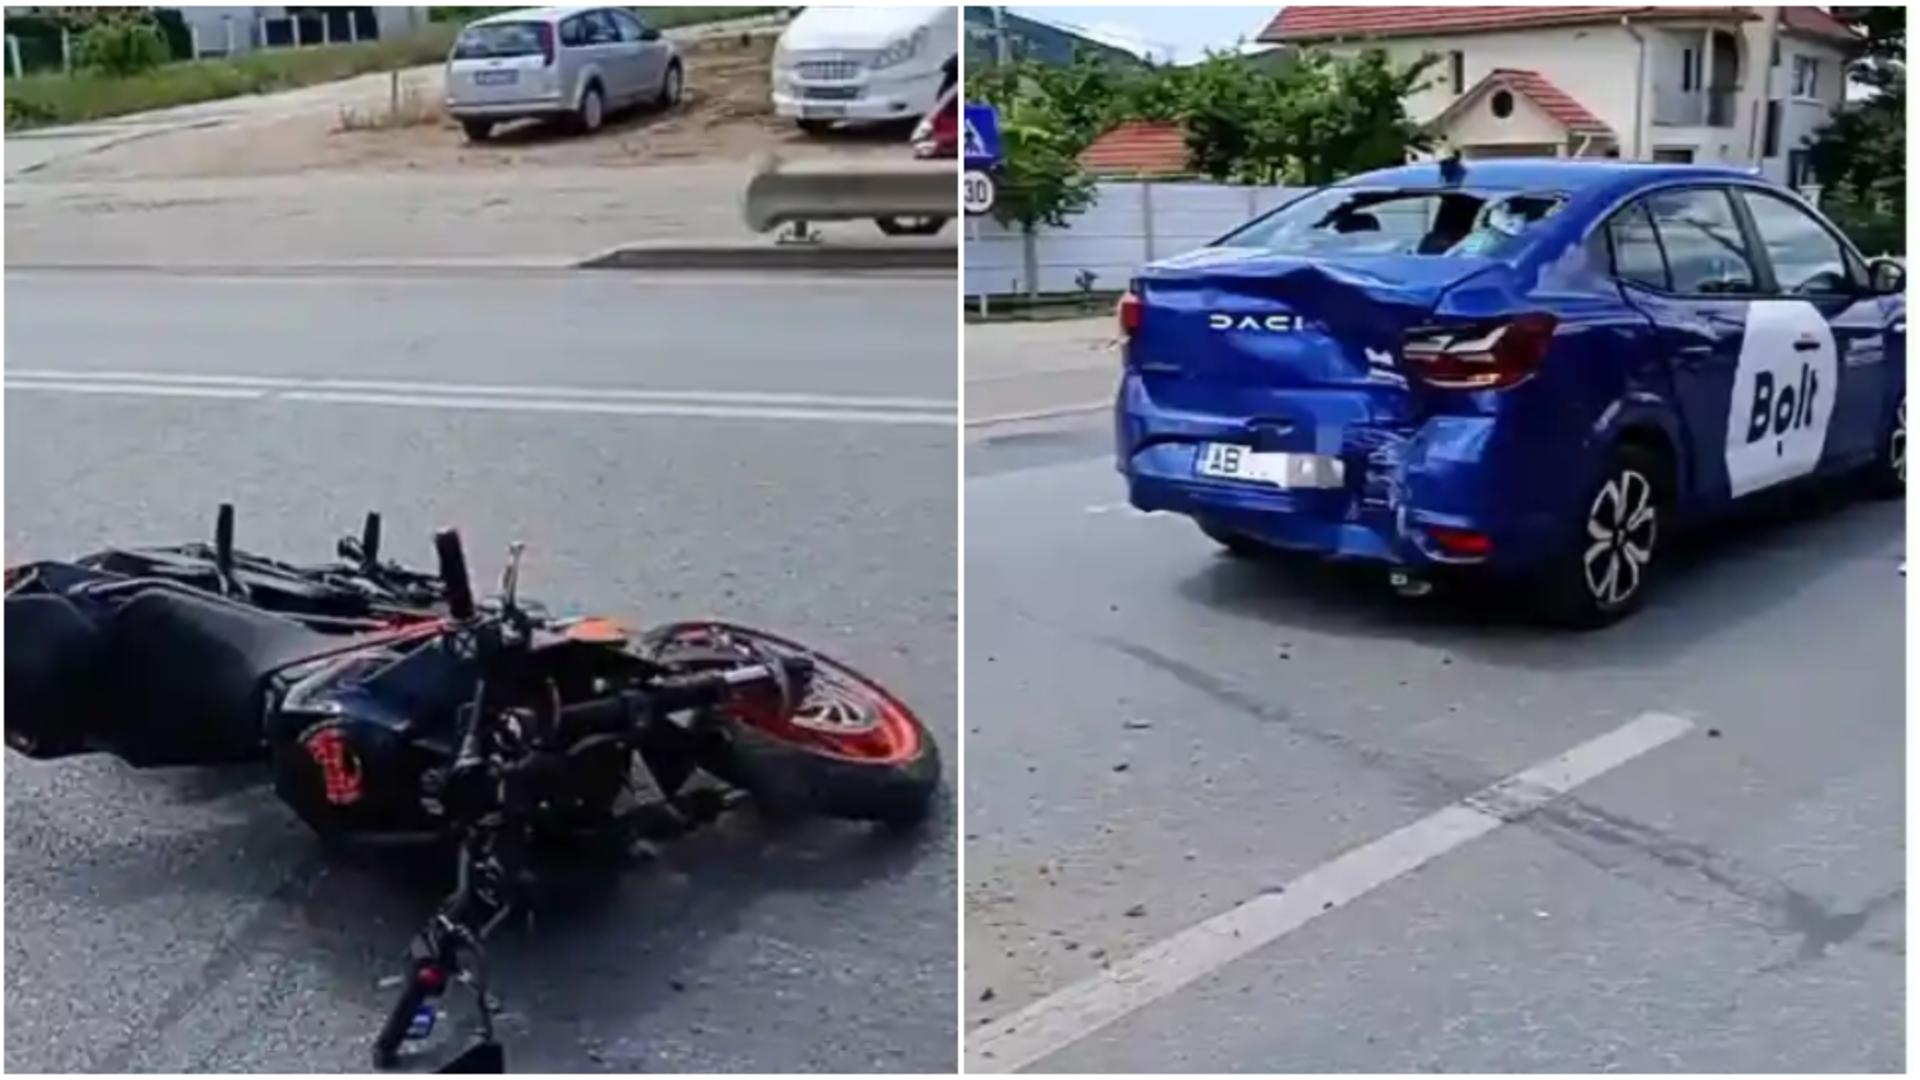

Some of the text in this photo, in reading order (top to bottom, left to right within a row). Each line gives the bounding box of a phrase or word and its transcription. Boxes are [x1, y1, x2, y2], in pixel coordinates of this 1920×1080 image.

[964, 179, 988, 203] 30
[1746, 362, 1818, 444] Bolt
[1210, 446, 1241, 473] AB
